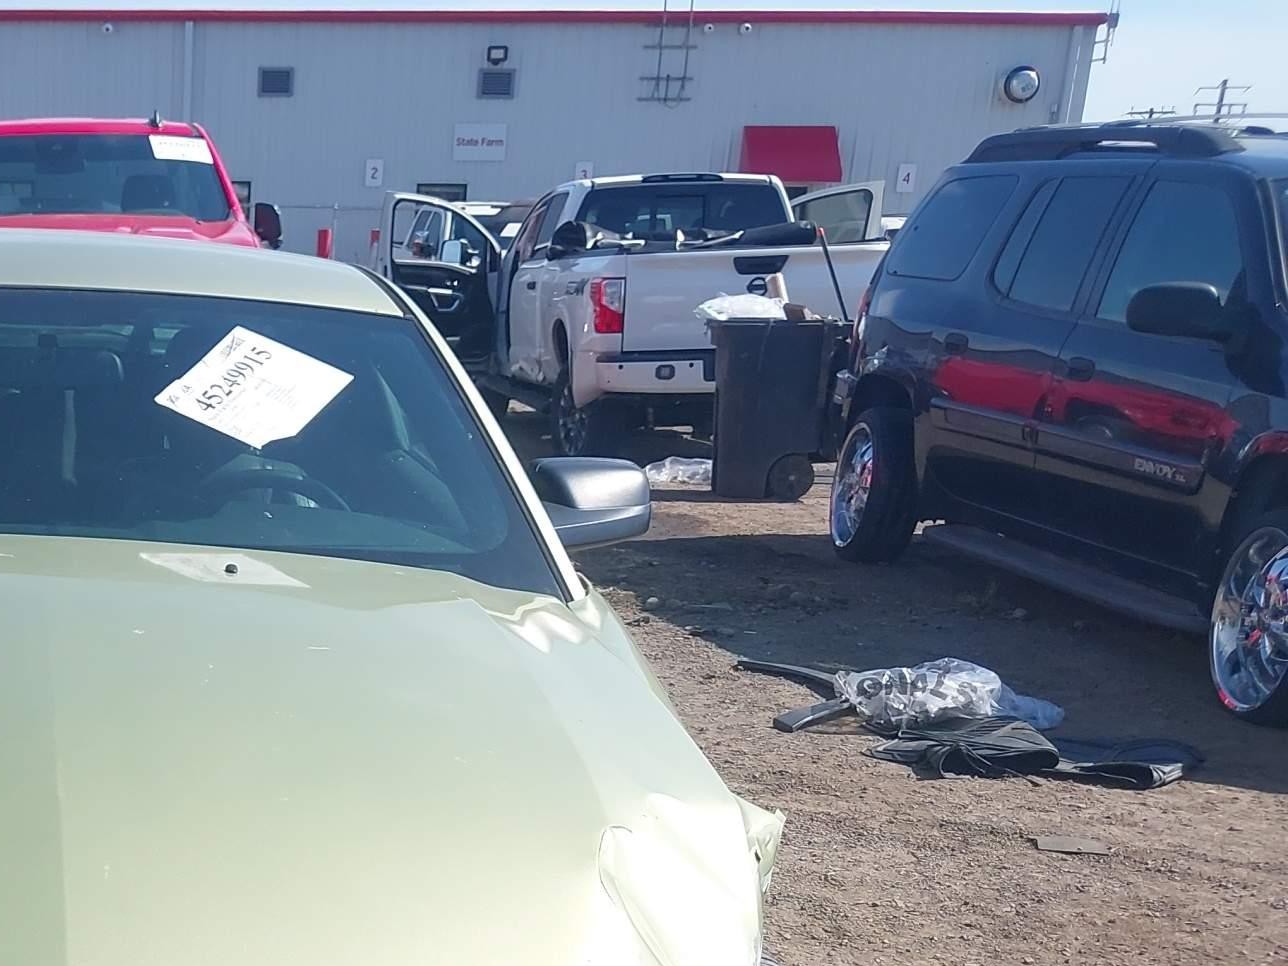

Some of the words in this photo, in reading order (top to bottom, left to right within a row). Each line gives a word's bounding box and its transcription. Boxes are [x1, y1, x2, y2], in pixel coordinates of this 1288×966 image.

[456, 137, 479, 147] State
[481, 137, 504, 147] Farm
[371, 167, 378, 180] 2
[902, 172, 911, 185] 4
[195, 346, 273, 411] 45249915
[1134, 458, 1176, 479] ENVOY
